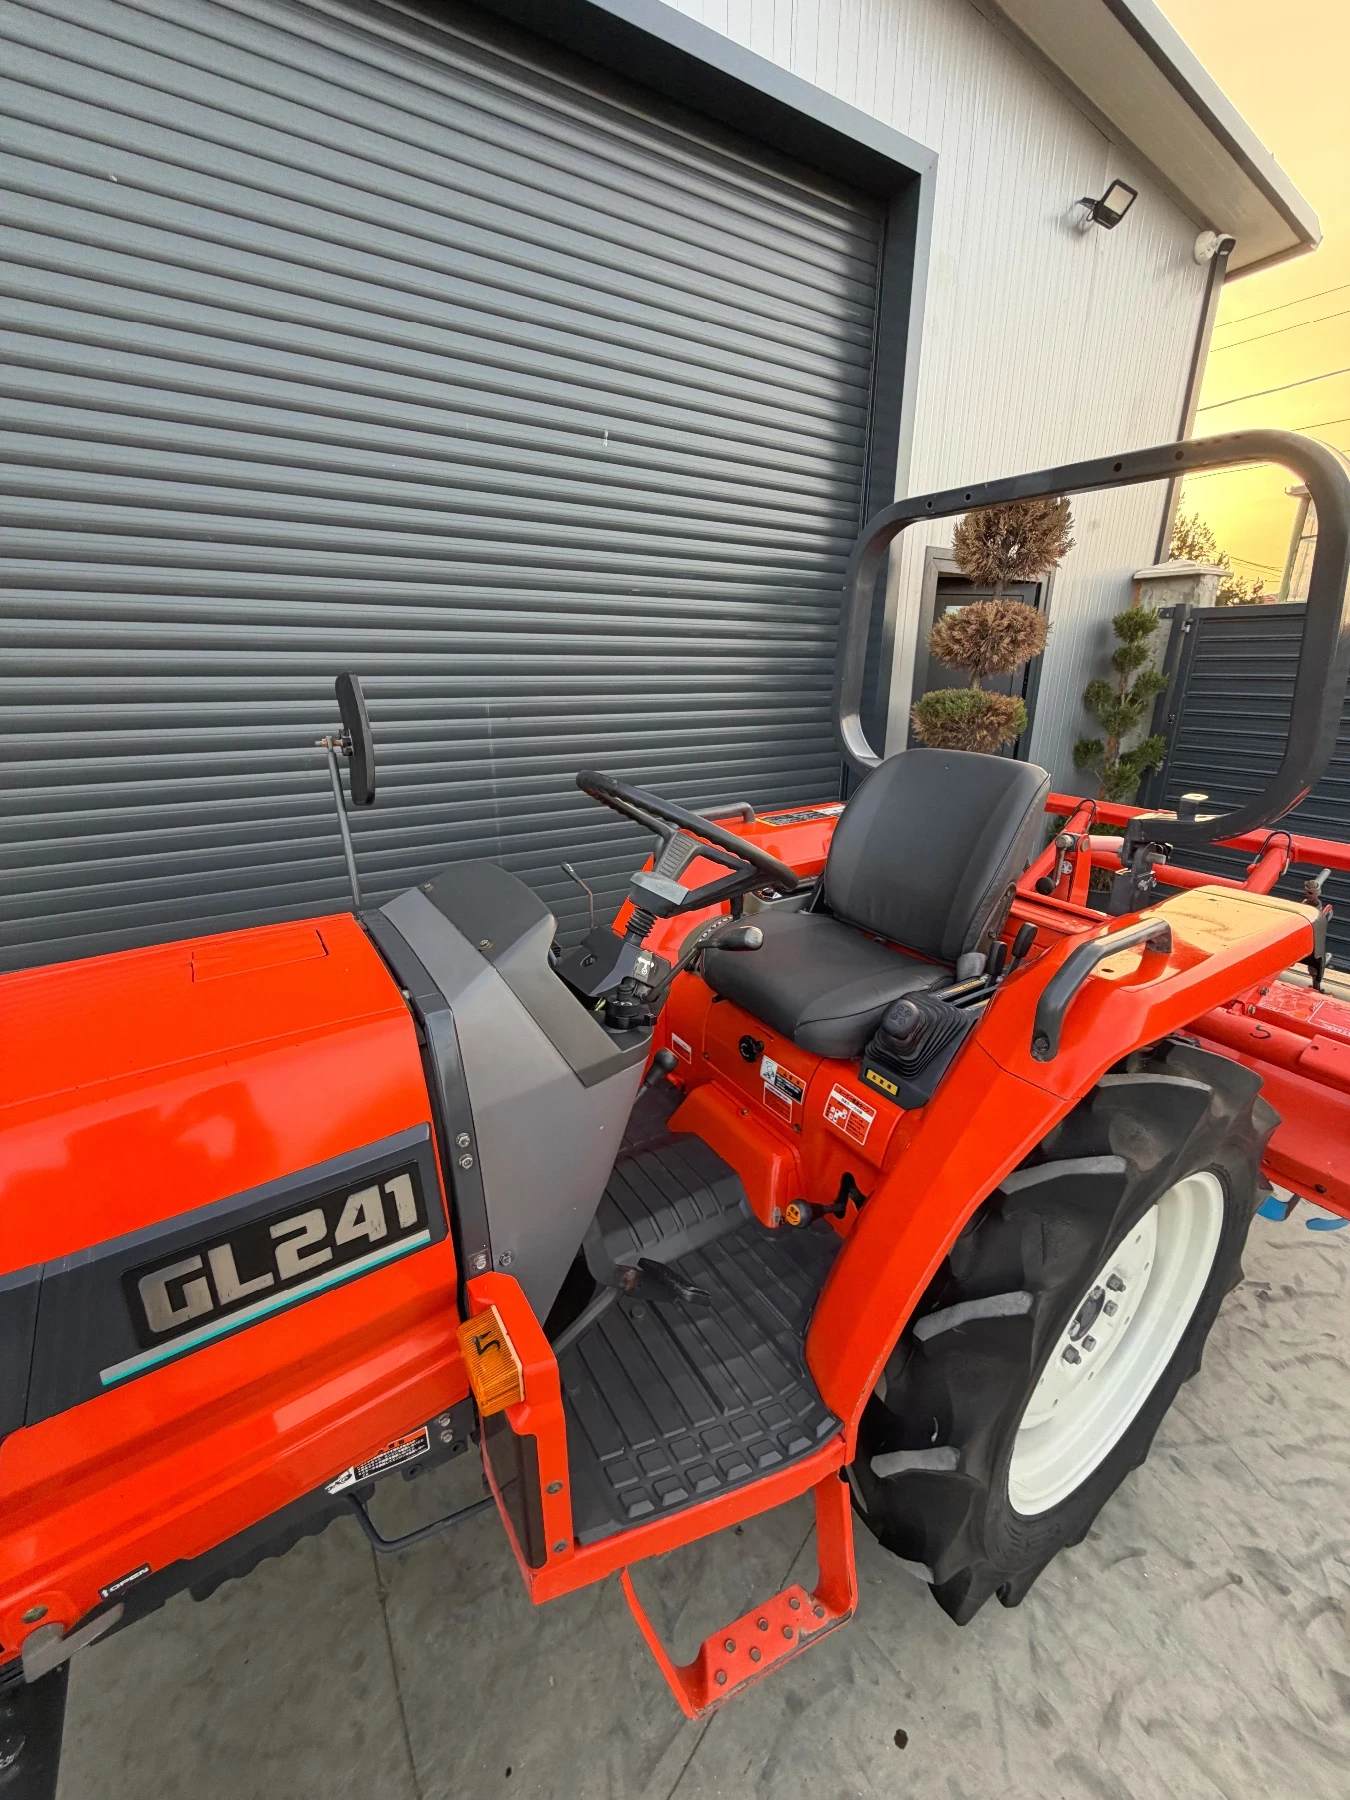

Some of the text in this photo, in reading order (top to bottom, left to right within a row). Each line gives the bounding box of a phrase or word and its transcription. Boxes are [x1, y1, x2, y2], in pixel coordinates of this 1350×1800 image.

[1249, 1024, 1271, 1040] 5
[138, 1173, 418, 1333] GL241
[109, 1566, 149, 1592] OPEN
